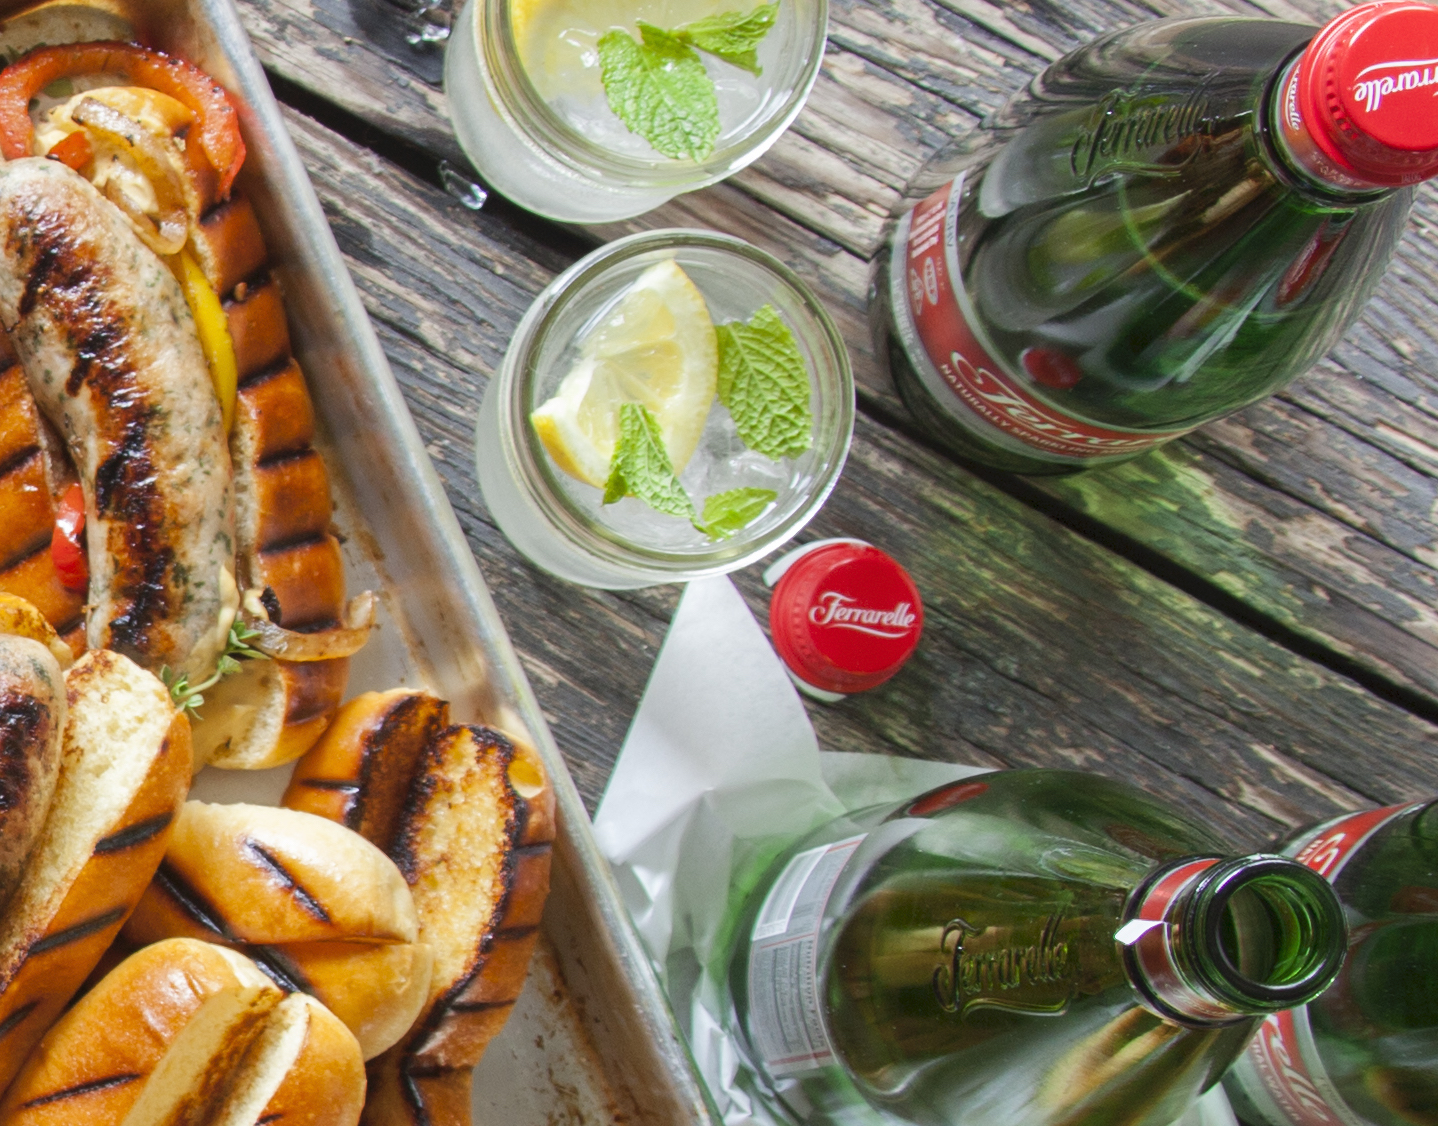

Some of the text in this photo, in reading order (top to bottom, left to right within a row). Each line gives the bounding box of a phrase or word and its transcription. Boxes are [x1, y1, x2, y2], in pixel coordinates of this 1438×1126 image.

[1352, 66, 1438, 113] rrarelle
[941, 364, 1011, 427] NATURALLY
[809, 591, 916, 627] Ferrarelle
